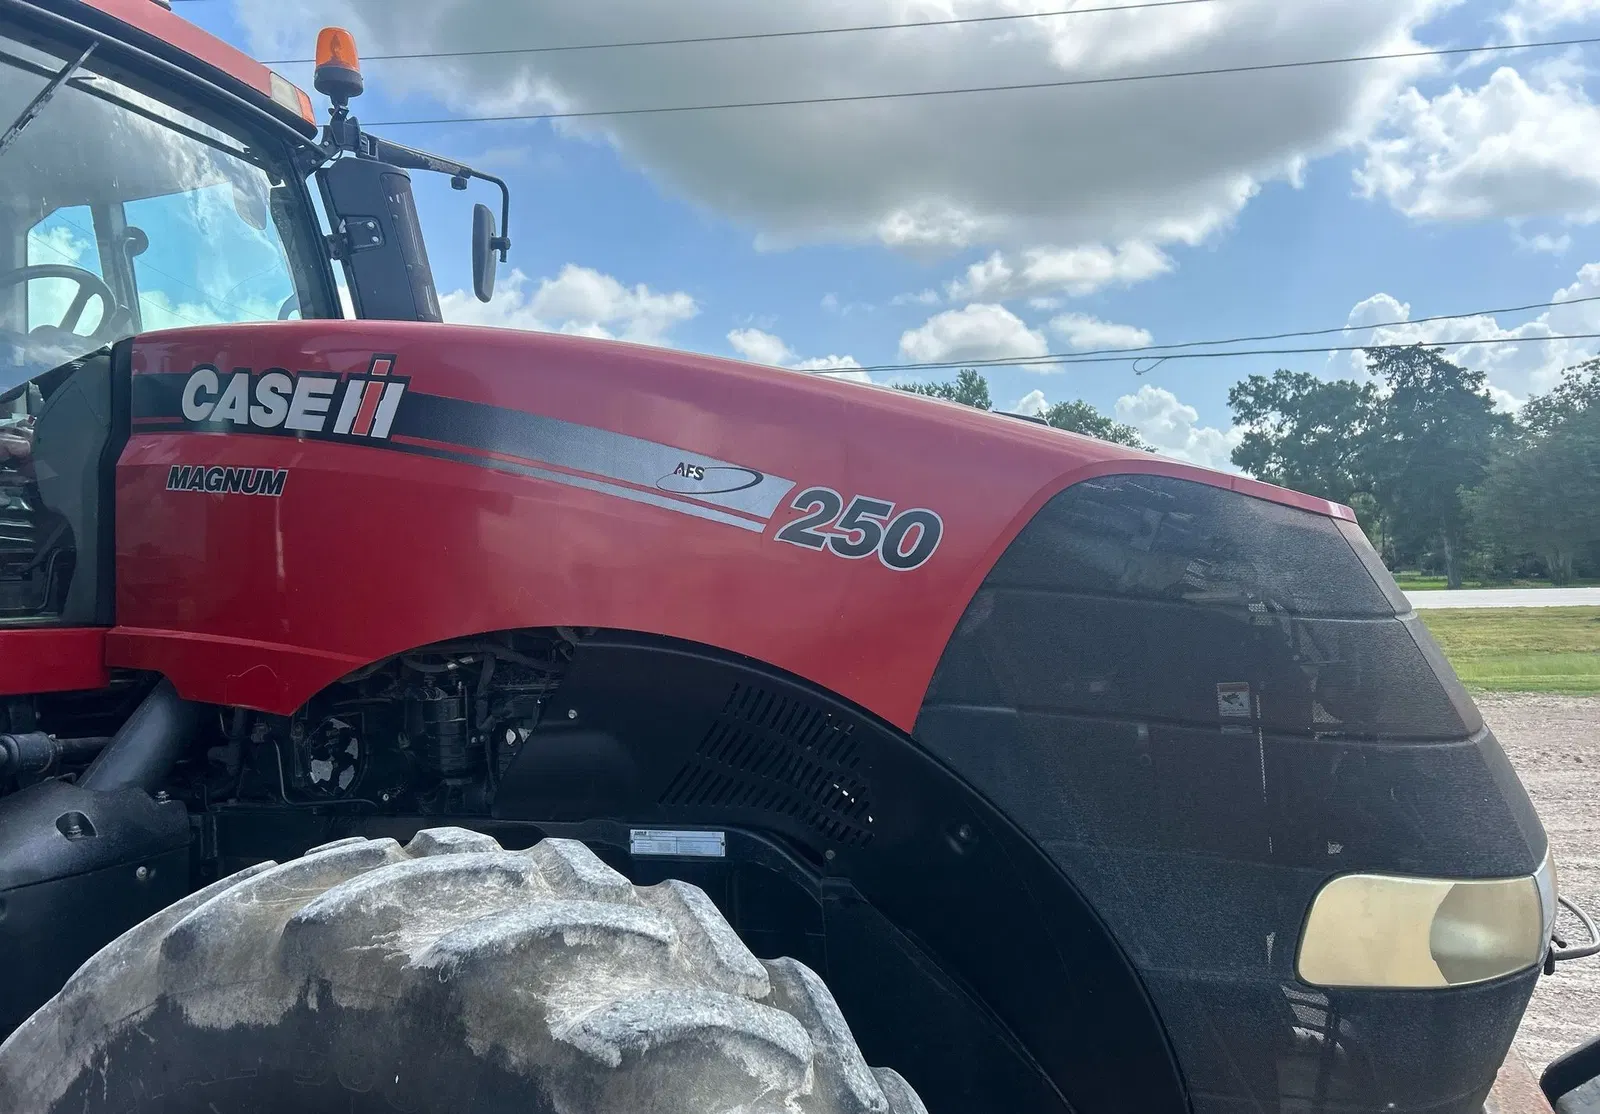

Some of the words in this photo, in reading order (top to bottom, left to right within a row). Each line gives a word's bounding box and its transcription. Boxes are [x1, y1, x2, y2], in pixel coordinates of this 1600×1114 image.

[182, 369, 338, 432] CASE
[166, 464, 288, 497] MAGNUM
[674, 462, 705, 481] AFS
[774, 486, 943, 571] 250
